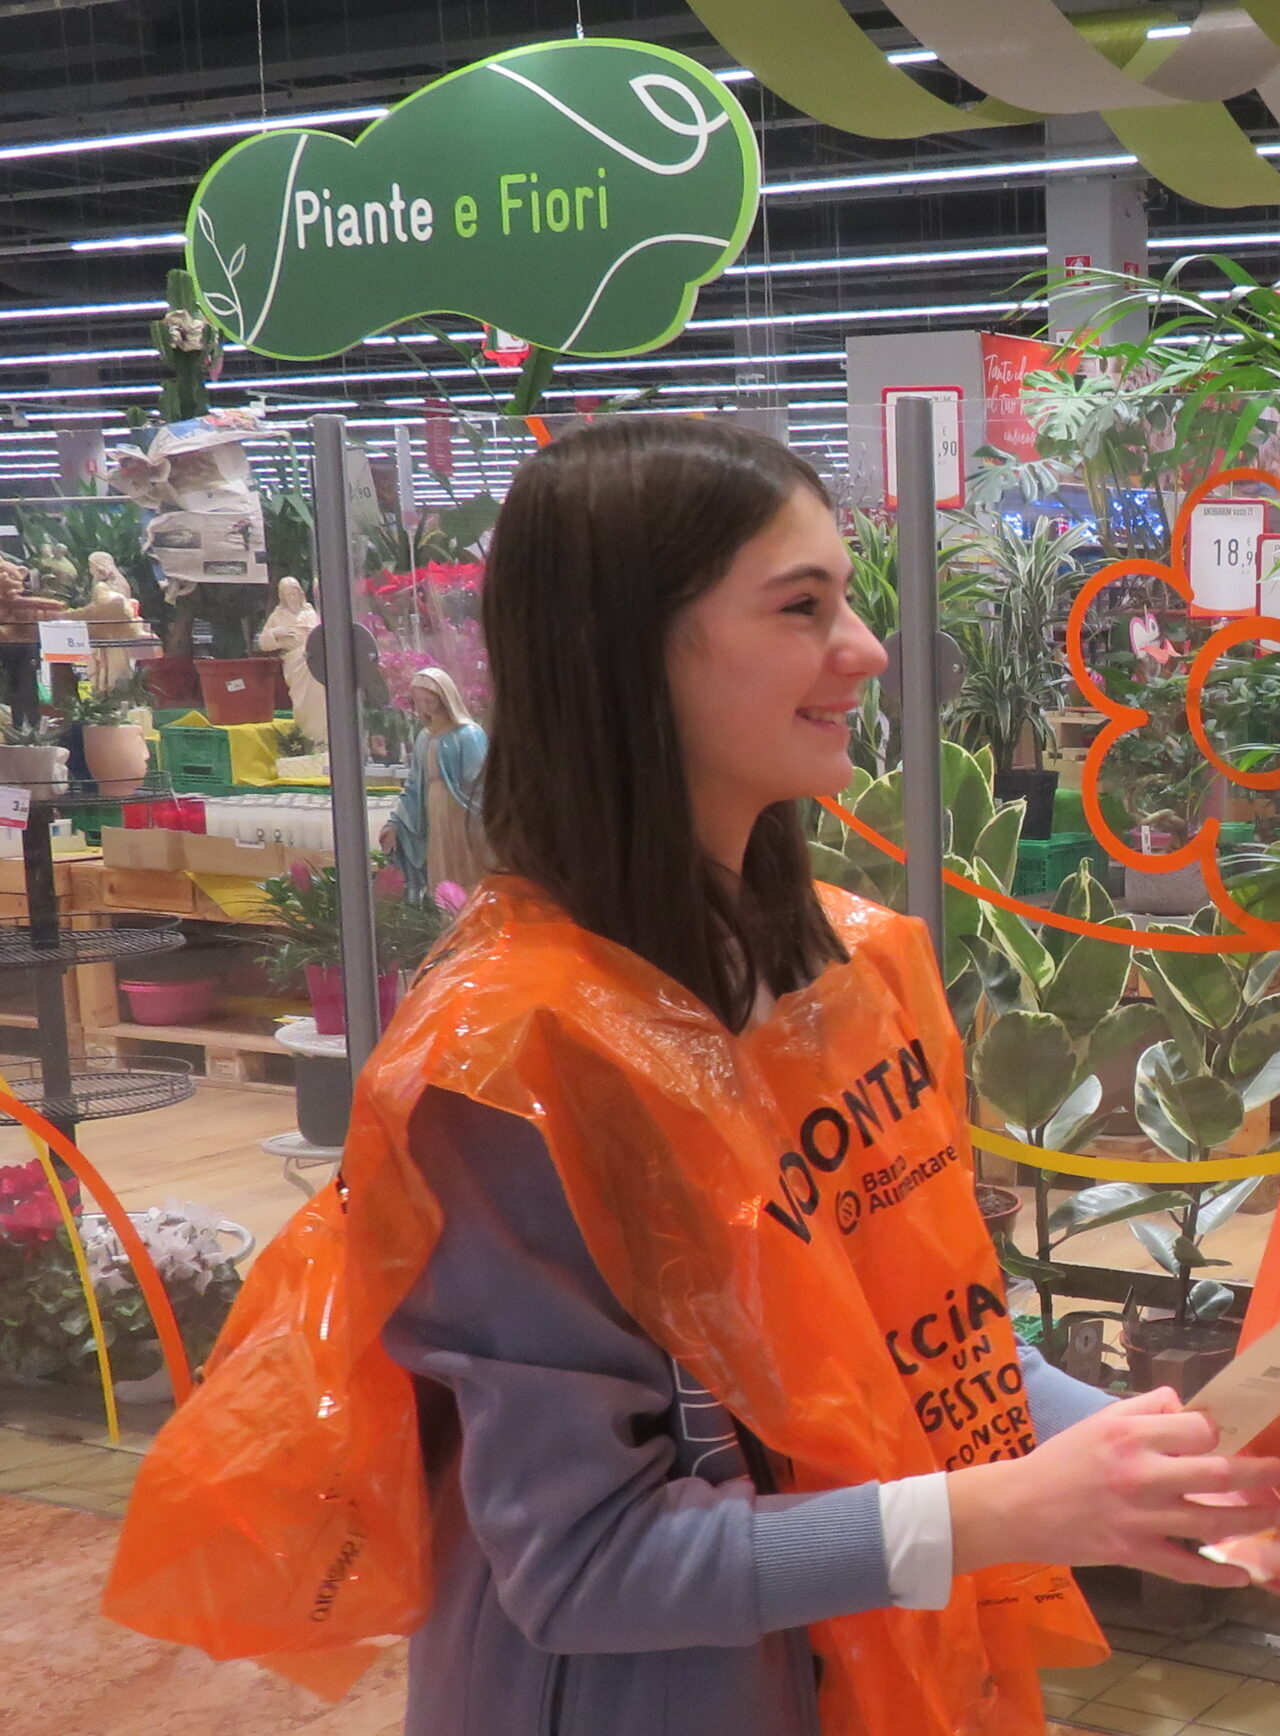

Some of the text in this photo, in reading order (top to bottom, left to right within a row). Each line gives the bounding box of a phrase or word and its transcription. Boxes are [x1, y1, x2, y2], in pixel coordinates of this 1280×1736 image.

[294, 167, 608, 249] Piante e Fiori
[1213, 538, 1254, 568] 18,9
[952, 1334, 992, 1370] UN
[915, 1362, 1023, 1433] GESTO
